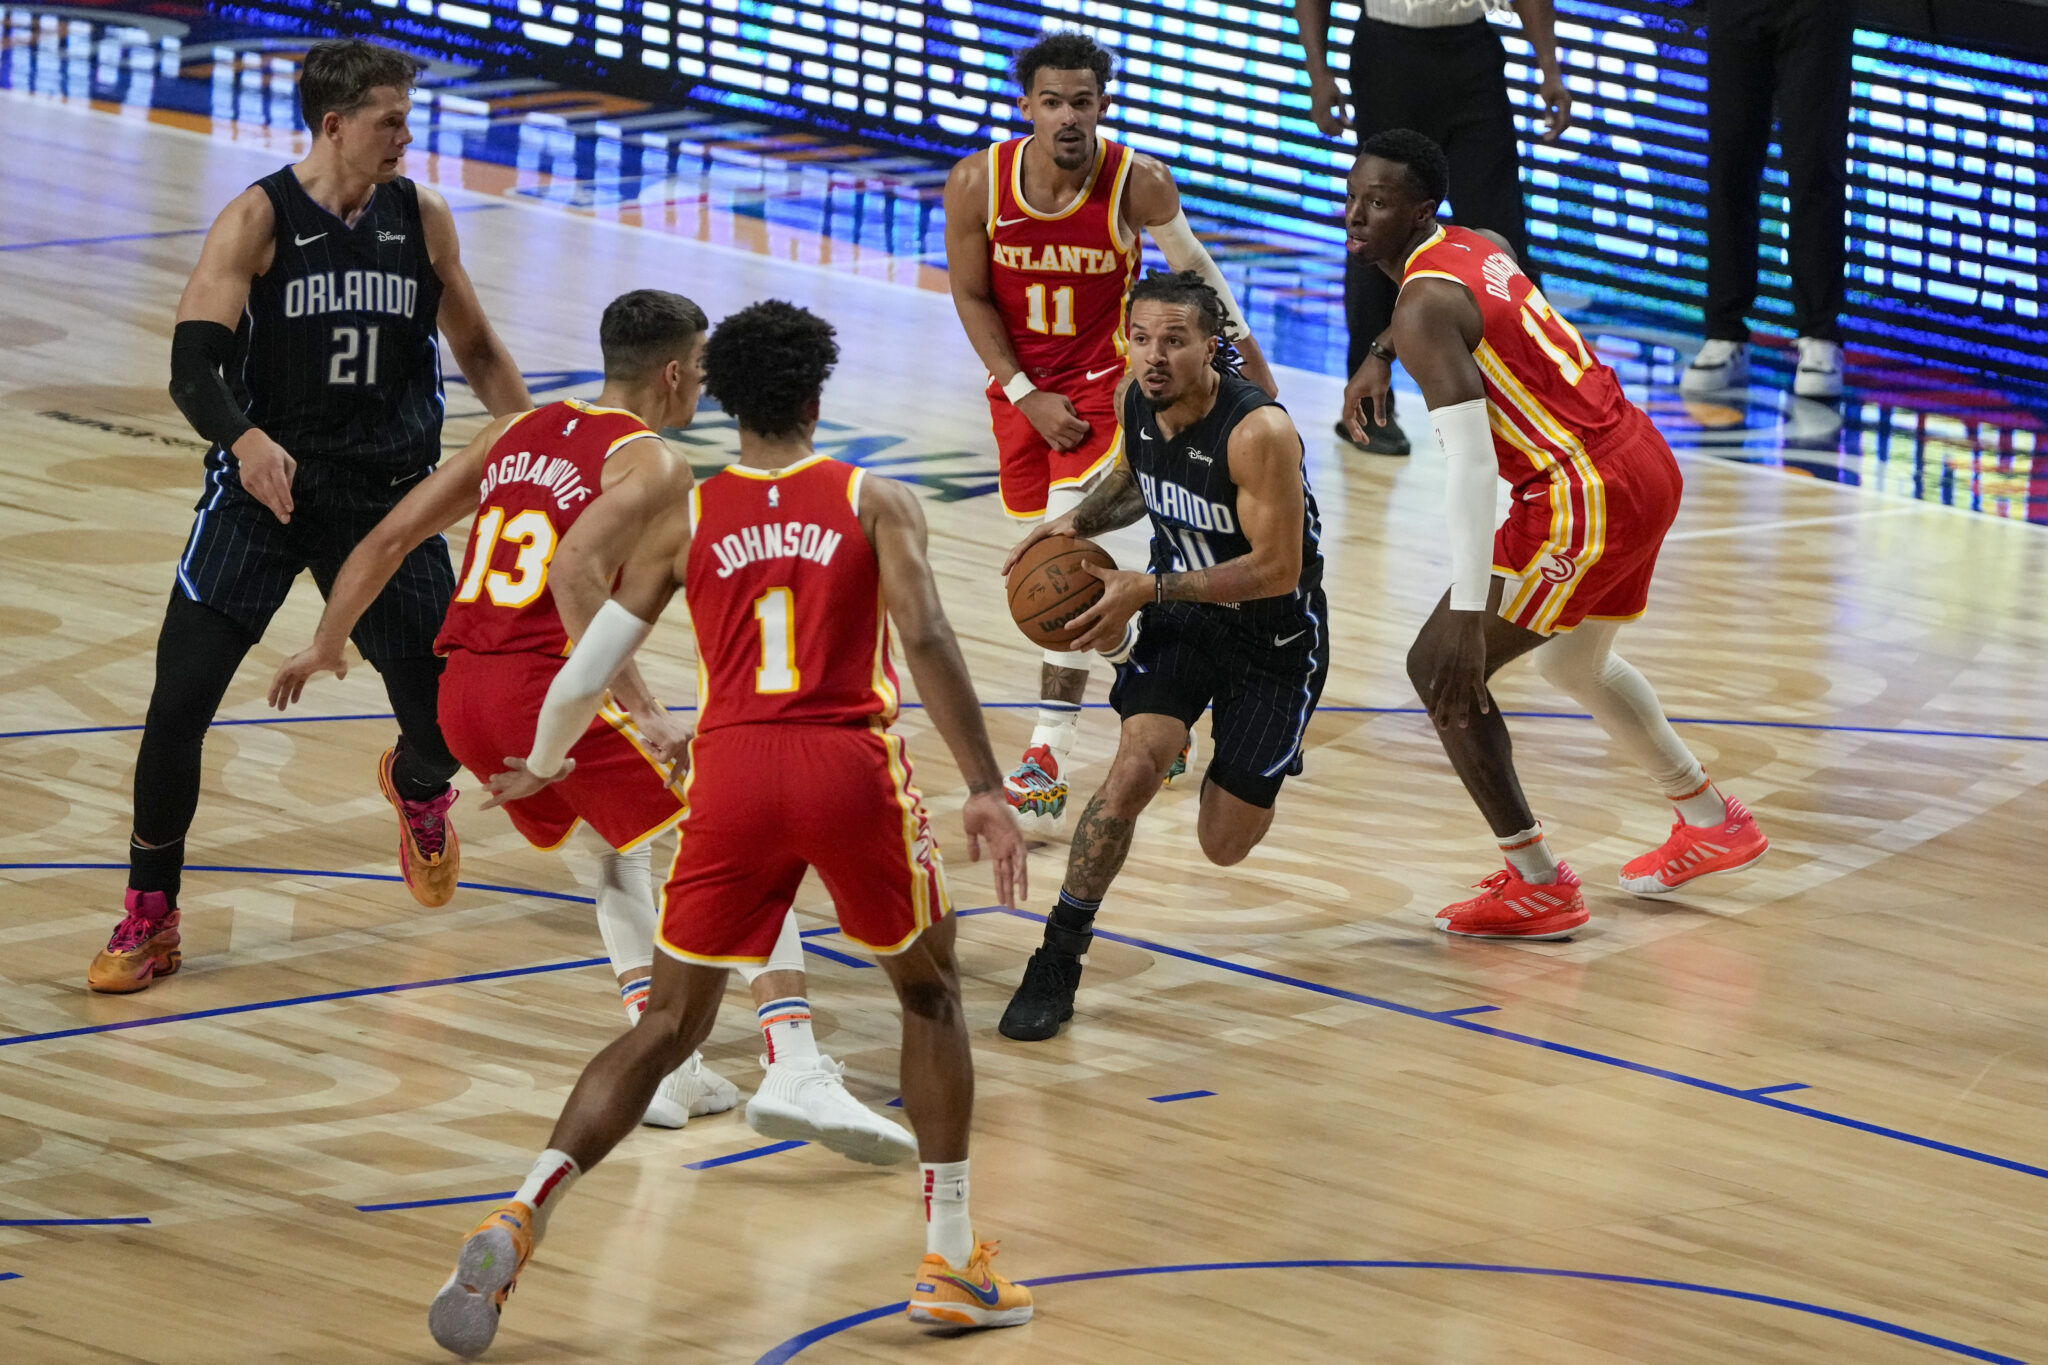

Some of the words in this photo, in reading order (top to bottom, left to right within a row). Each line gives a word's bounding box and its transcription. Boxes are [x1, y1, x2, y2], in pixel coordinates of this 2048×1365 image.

[376, 230, 406, 244] Disney
[993, 242, 1117, 275] ATLANTA
[285, 270, 418, 319] ORLANDO
[1025, 283, 1077, 336] 11
[328, 326, 380, 385] 21
[1520, 285, 1593, 387] 17
[1186, 446, 1214, 466] Disney
[1137, 470, 1236, 534] RLANDO
[455, 506, 559, 609] 13
[711, 521, 843, 579] JOHNSON
[754, 586, 800, 694] 1
